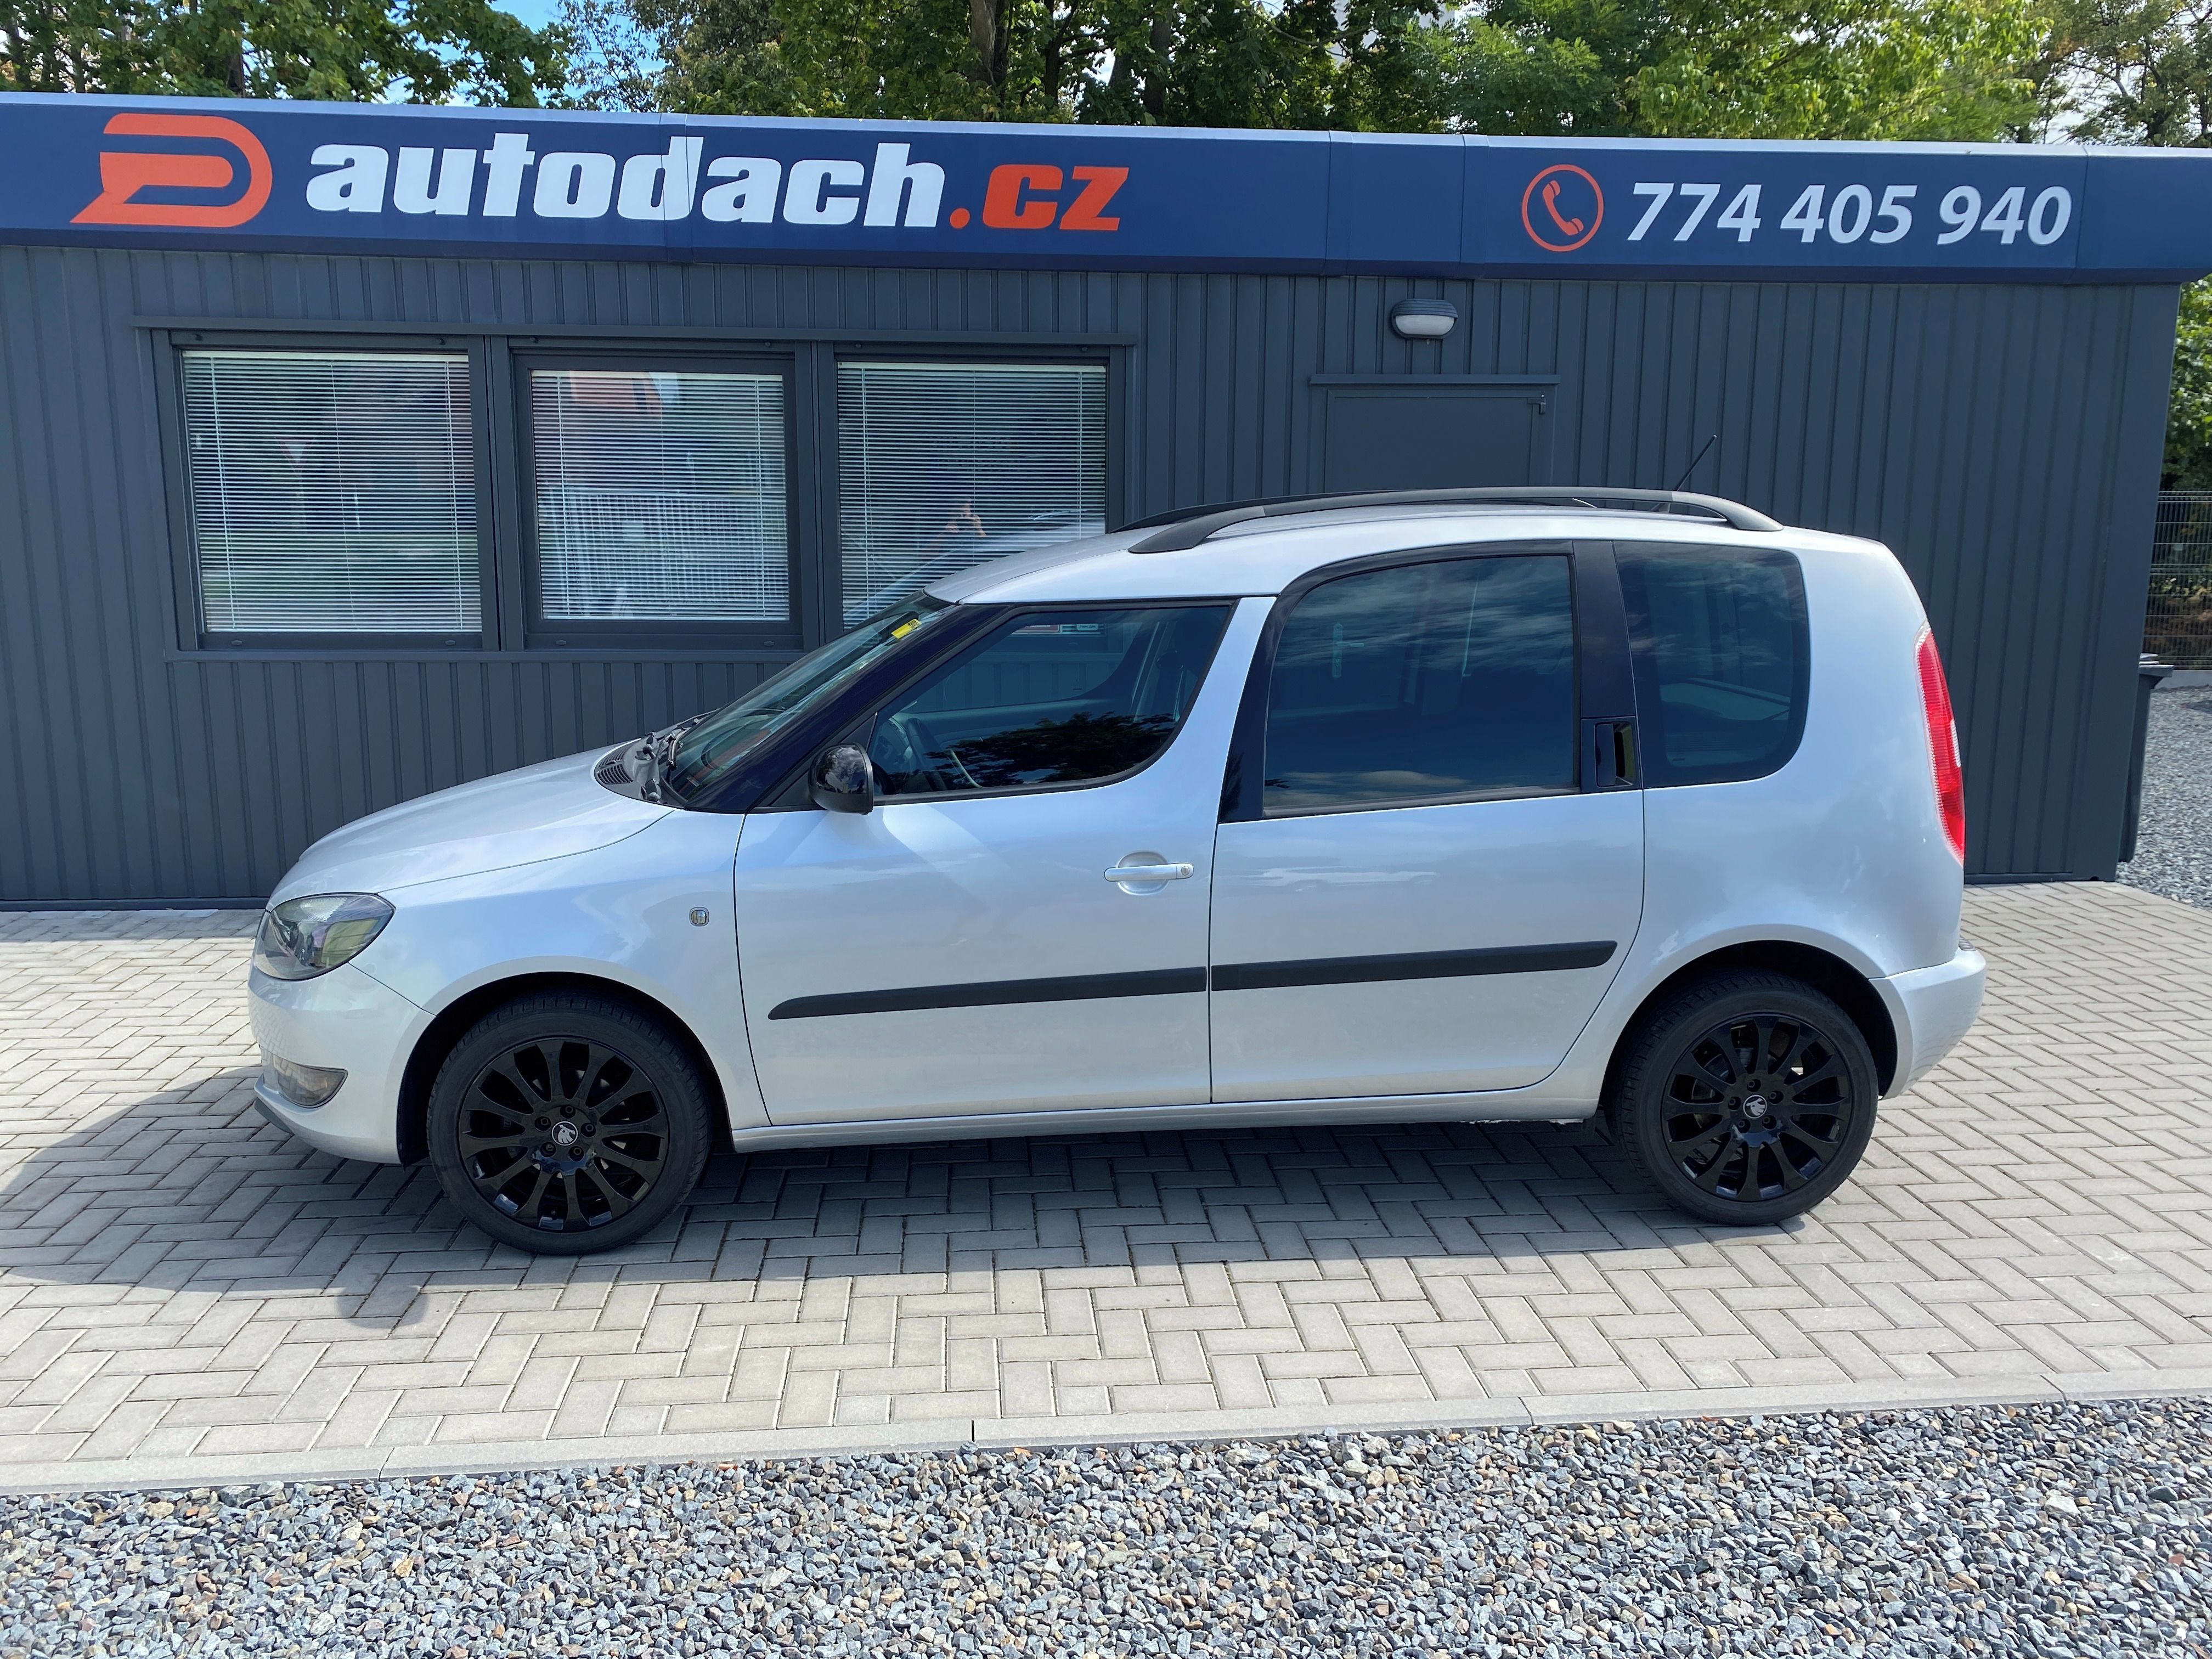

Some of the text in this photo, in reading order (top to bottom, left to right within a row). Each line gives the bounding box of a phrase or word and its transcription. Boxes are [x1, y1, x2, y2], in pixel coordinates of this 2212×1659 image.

[306, 132, 1129, 230] autodach.cz
[1627, 182, 2071, 245] 774 405 940
